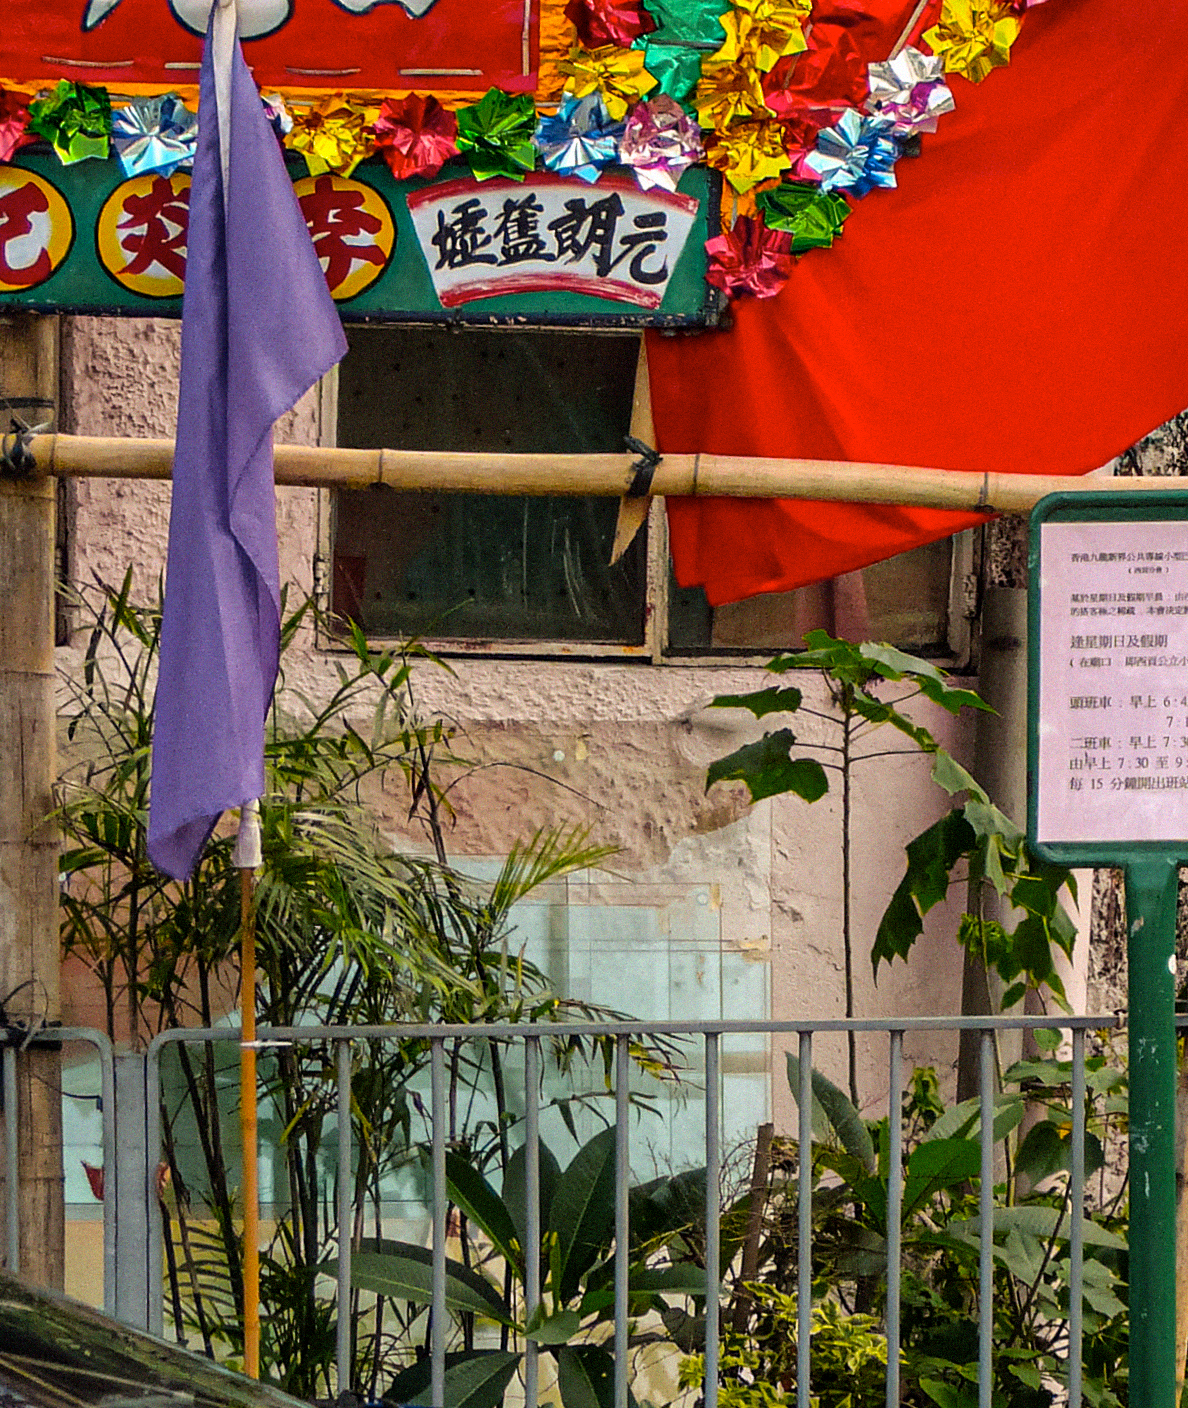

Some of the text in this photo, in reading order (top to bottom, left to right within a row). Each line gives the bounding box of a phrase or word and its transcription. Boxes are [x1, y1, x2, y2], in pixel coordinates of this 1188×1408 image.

[1069, 634, 1169, 649] 逢星期日及假期
[1118, 757, 1149, 770] 7:30
[1156, 756, 1170, 769] 至
[1070, 776, 1083, 791] 每
[1091, 777, 1104, 790] 15
